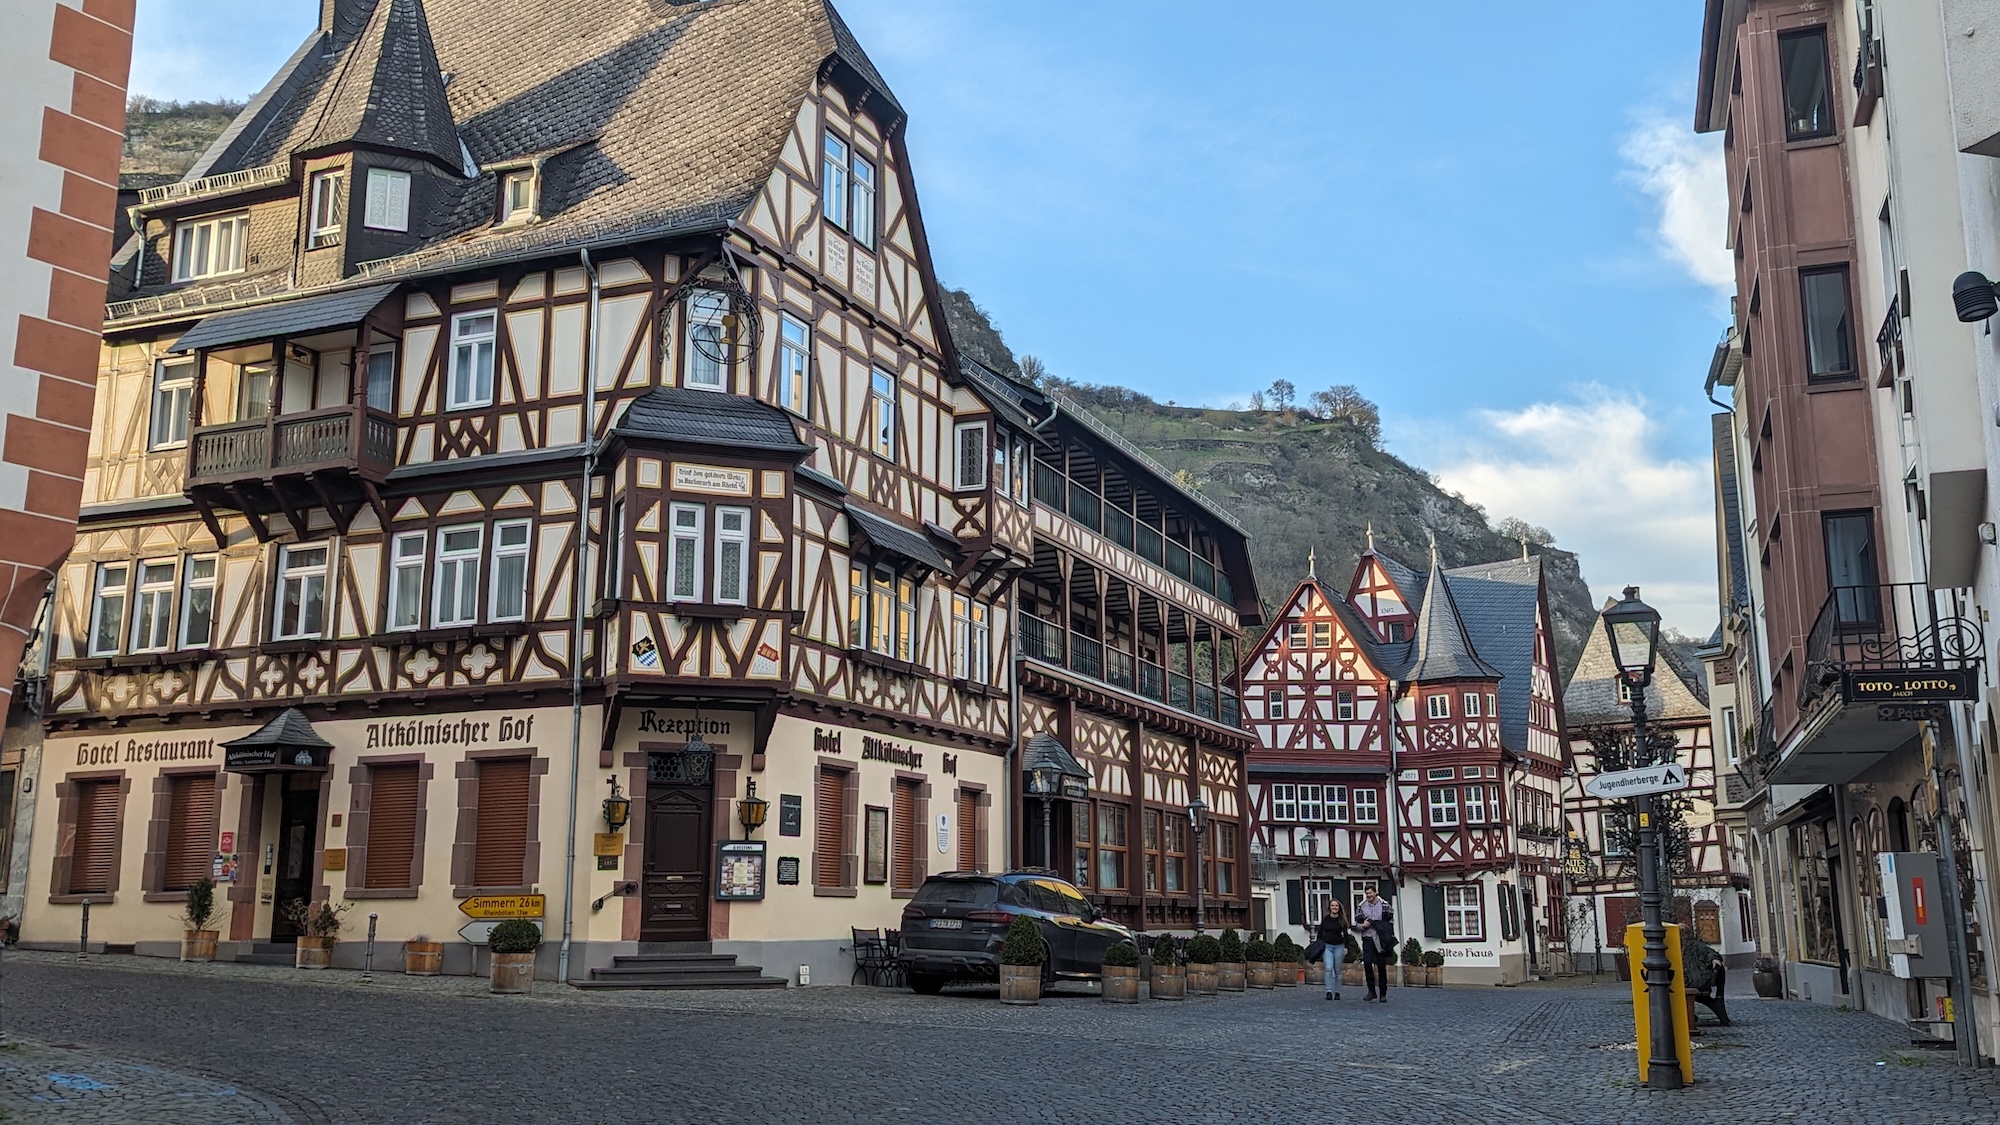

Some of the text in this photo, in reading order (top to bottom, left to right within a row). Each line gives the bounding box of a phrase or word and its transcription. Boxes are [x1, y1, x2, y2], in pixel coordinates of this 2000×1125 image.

[1858, 682, 1893, 692] TOTO
[1904, 679, 1948, 691] LOTTO
[1897, 707, 1926, 718] Post
[366, 714, 534, 749] Altkölnischer Hof
[638, 709, 731, 742] Rezeption
[76, 737, 214, 766] Hotel Restaurant
[263, 750, 276, 759] Hof
[814, 726, 958, 779] Hotel Altkölnischer Hof
[1599, 775, 1659, 791] Jugendherberge
[1565, 859, 1586, 867] ALTES
[1565, 866, 1586, 875] HAUS
[473, 898, 515, 908] Simmern
[519, 897, 530, 908] 26
[1465, 947, 1494, 958] Haus
